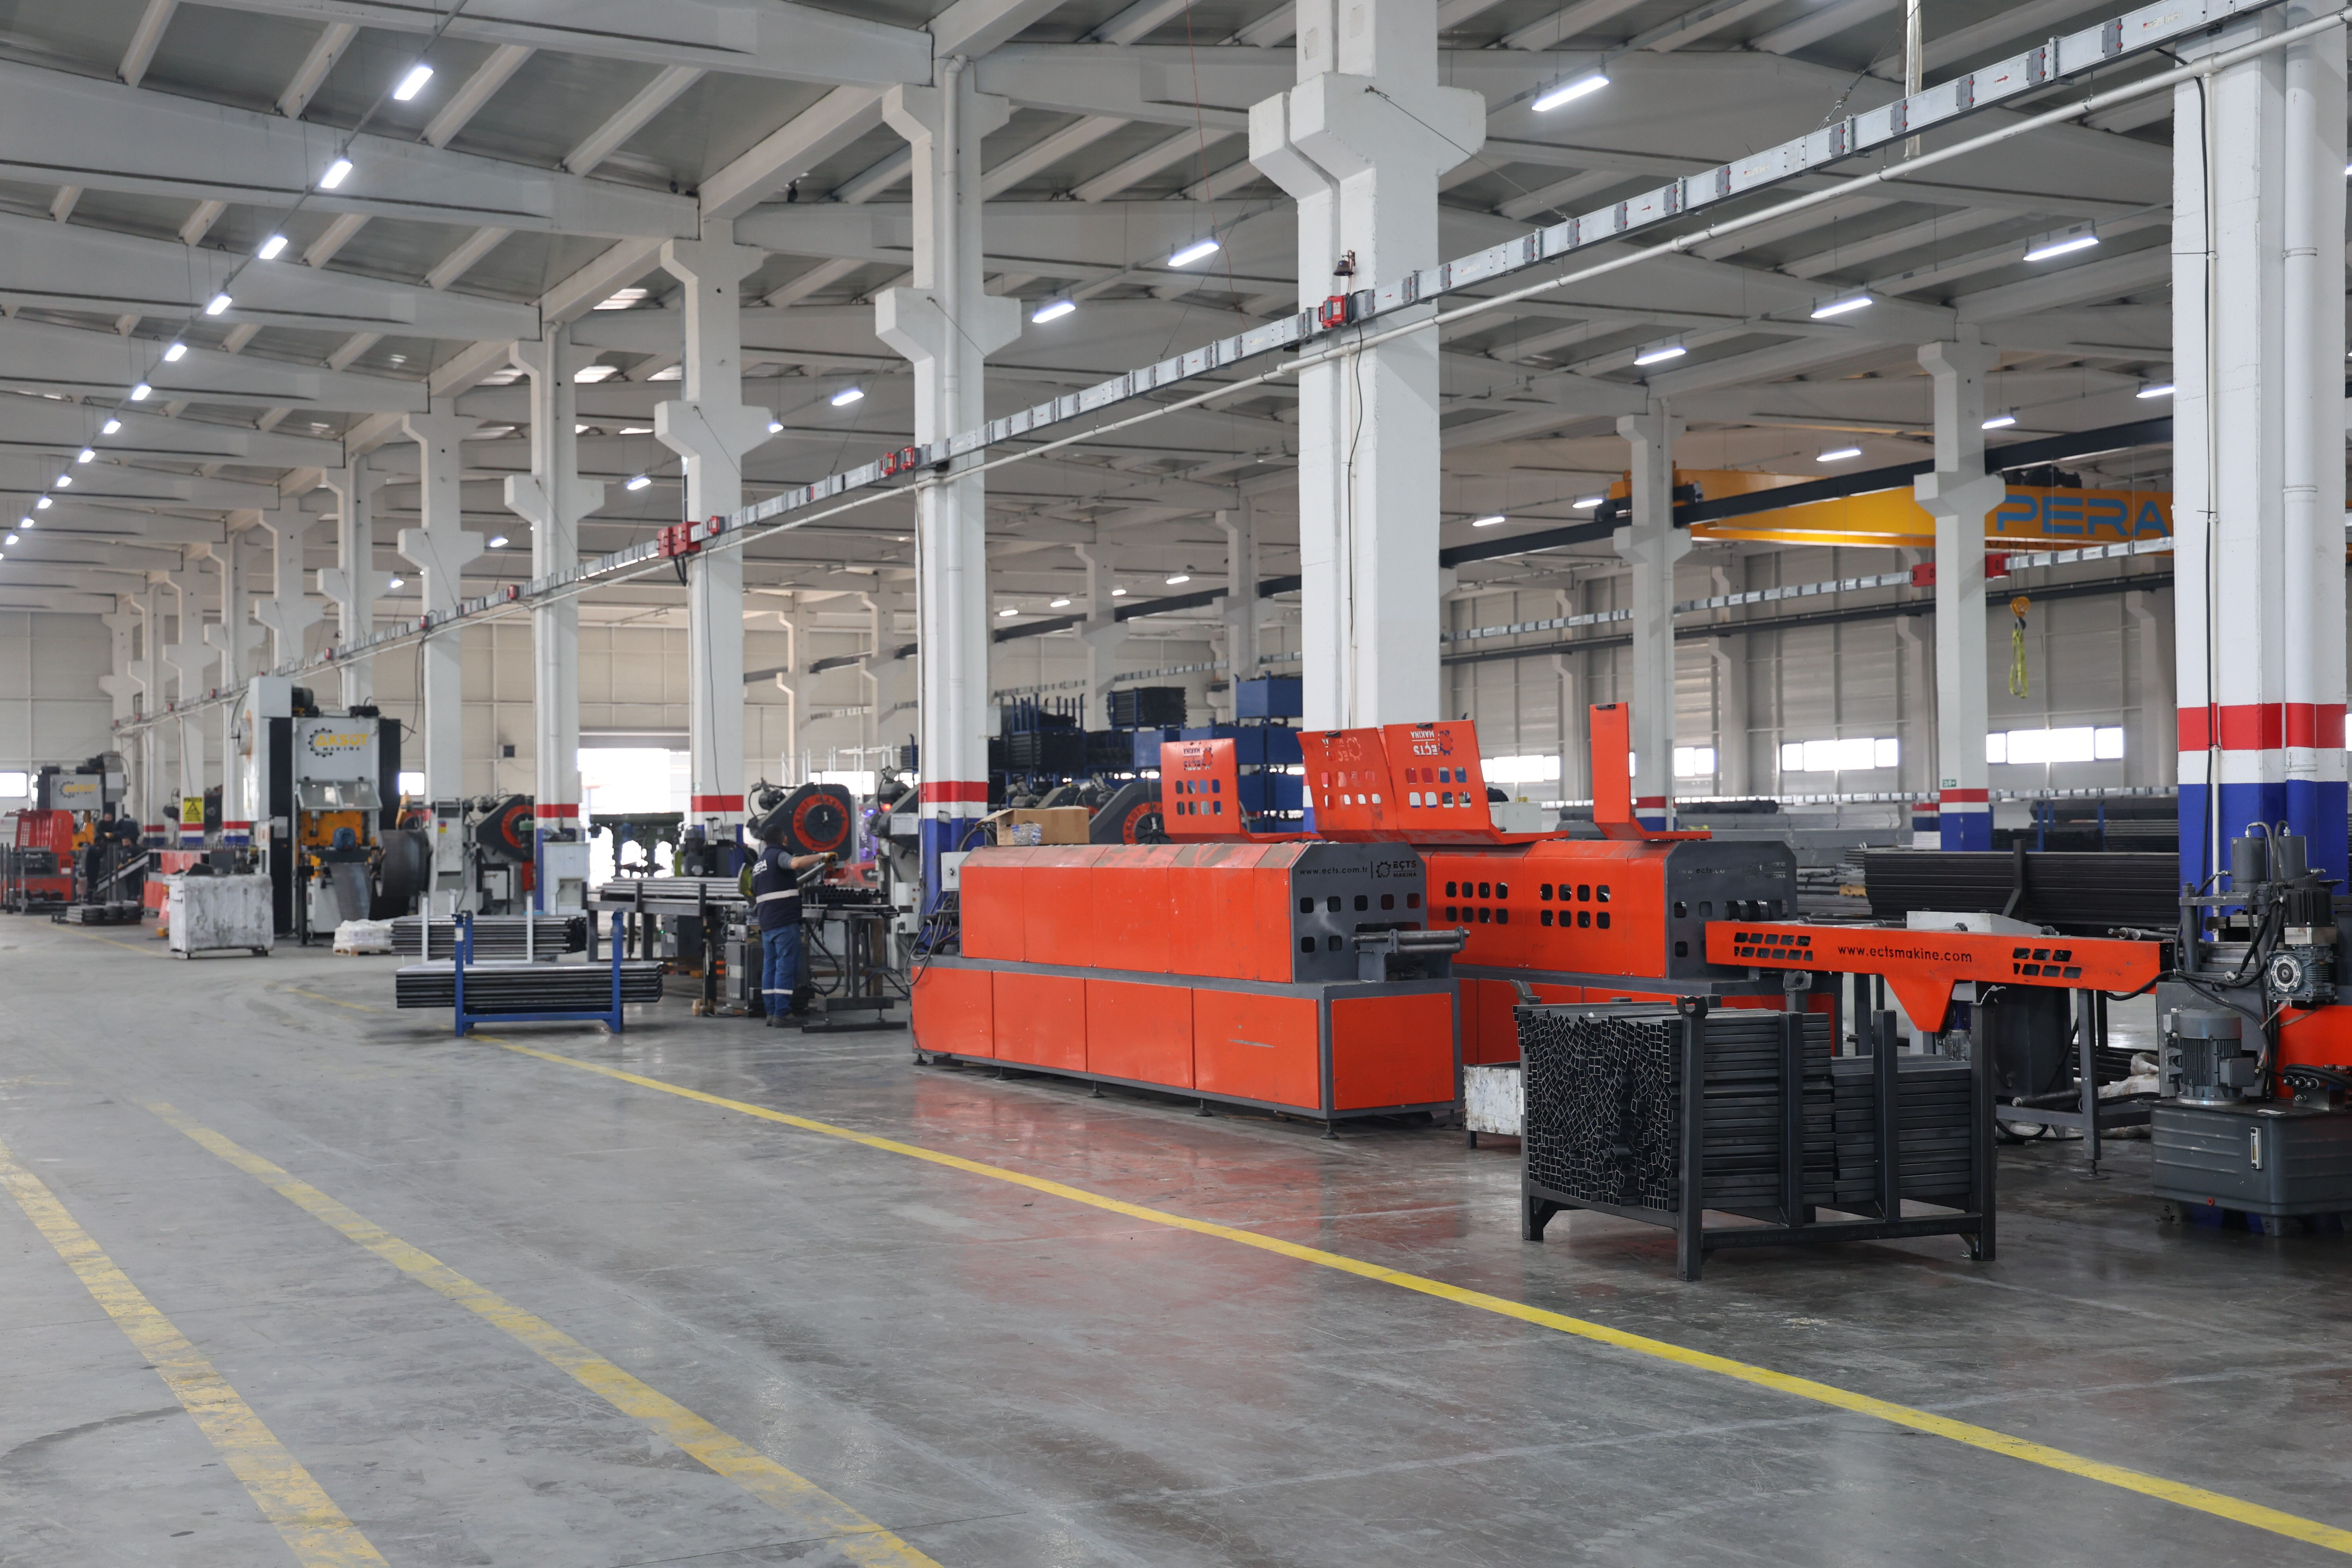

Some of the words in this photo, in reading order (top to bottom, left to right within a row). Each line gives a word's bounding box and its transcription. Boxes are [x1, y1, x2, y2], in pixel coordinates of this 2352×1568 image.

[1997, 494, 2171, 537] PERA
[1299, 866, 1368, 875] www.ects.com.tr
[1393, 860, 1417, 870] EÇTS
[1838, 942, 1972, 962] www.ectsmakine.com
